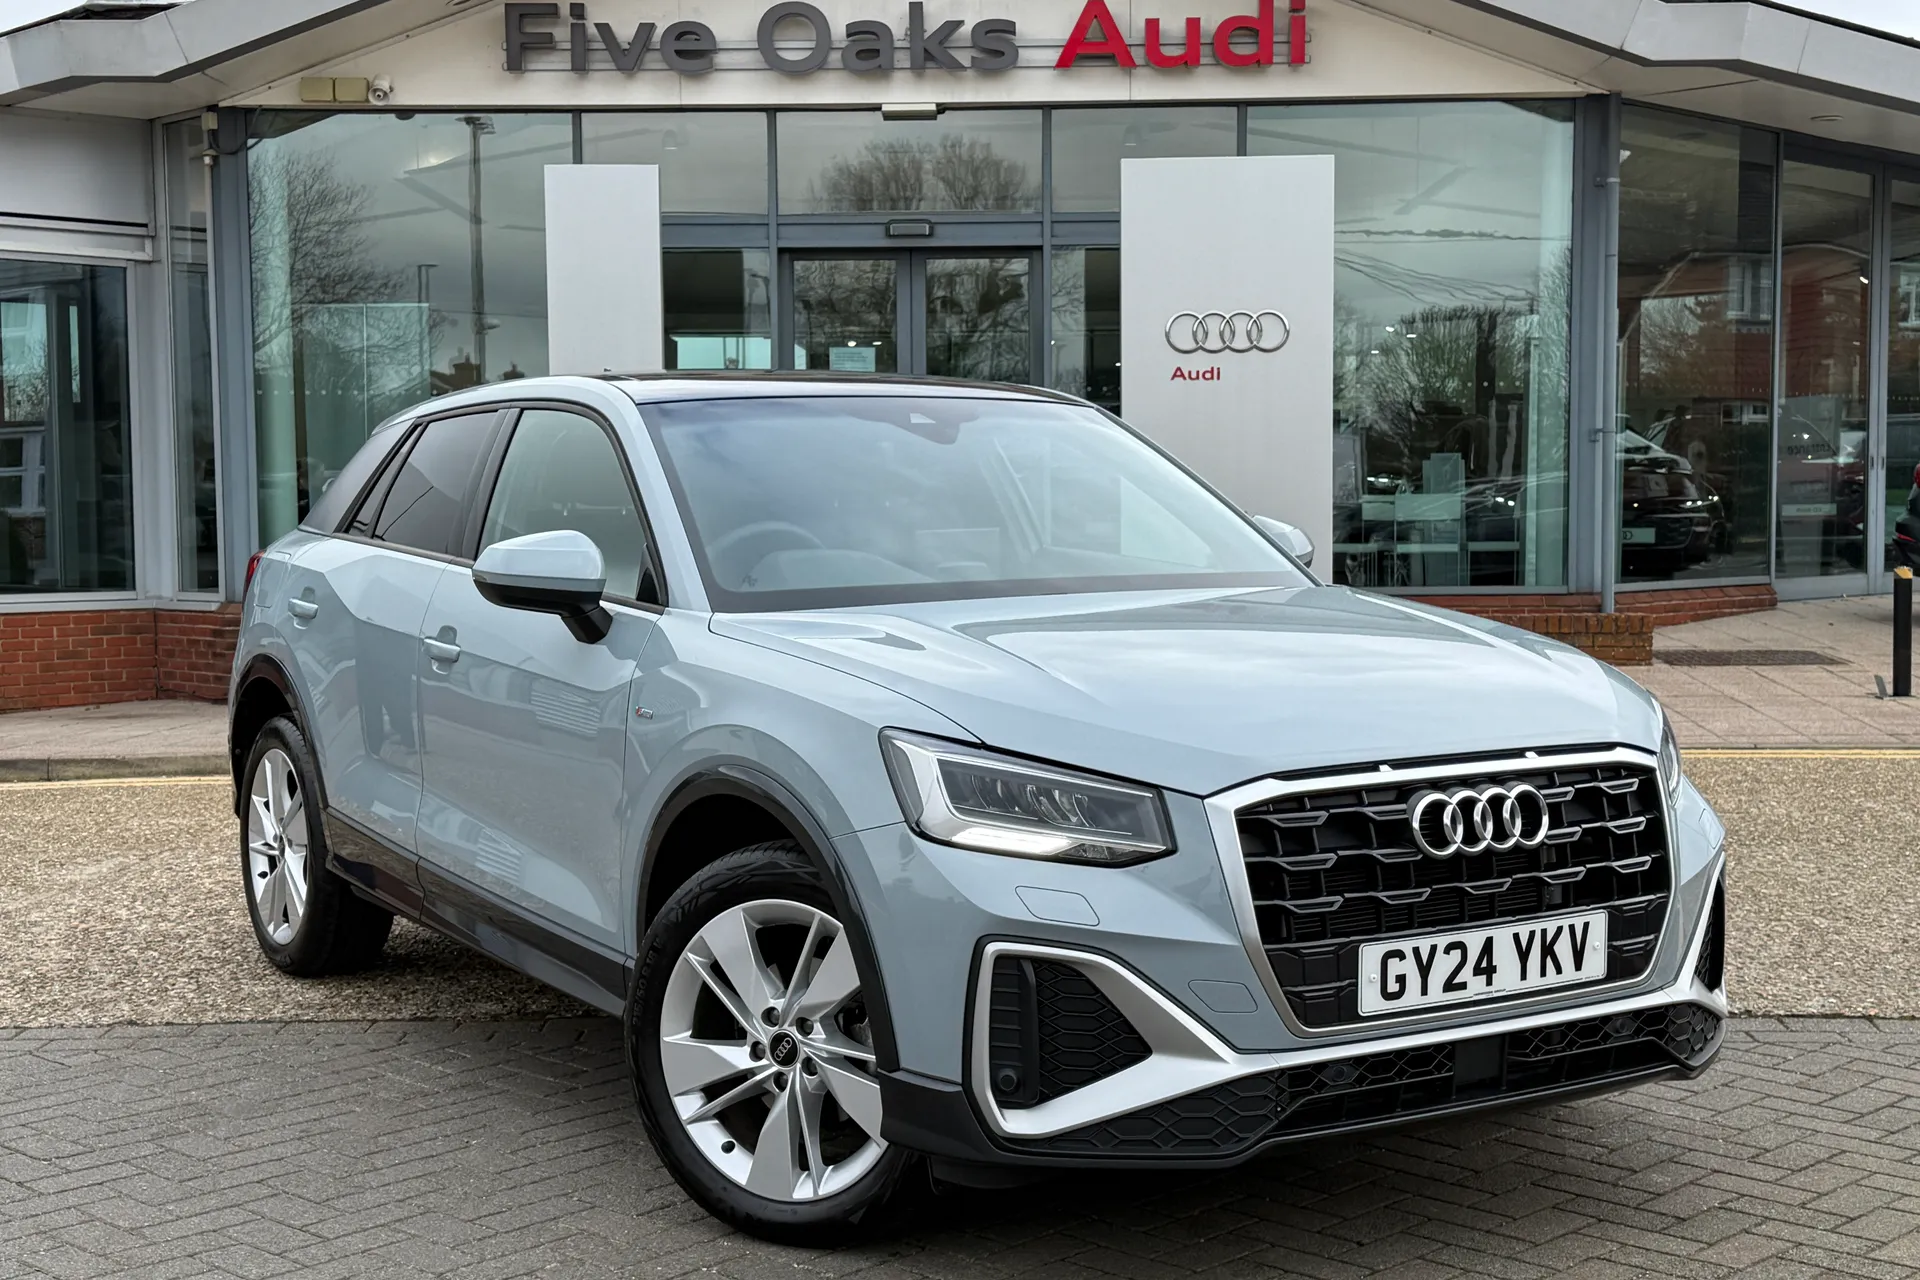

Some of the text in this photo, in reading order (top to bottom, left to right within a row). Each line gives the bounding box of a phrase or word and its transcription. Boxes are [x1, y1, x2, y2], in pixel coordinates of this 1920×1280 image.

[504, 0, 1307, 75] Five Oaks Audi
[1170, 366, 1221, 381] Audi
[1379, 920, 1591, 1002] GY24 YKV
